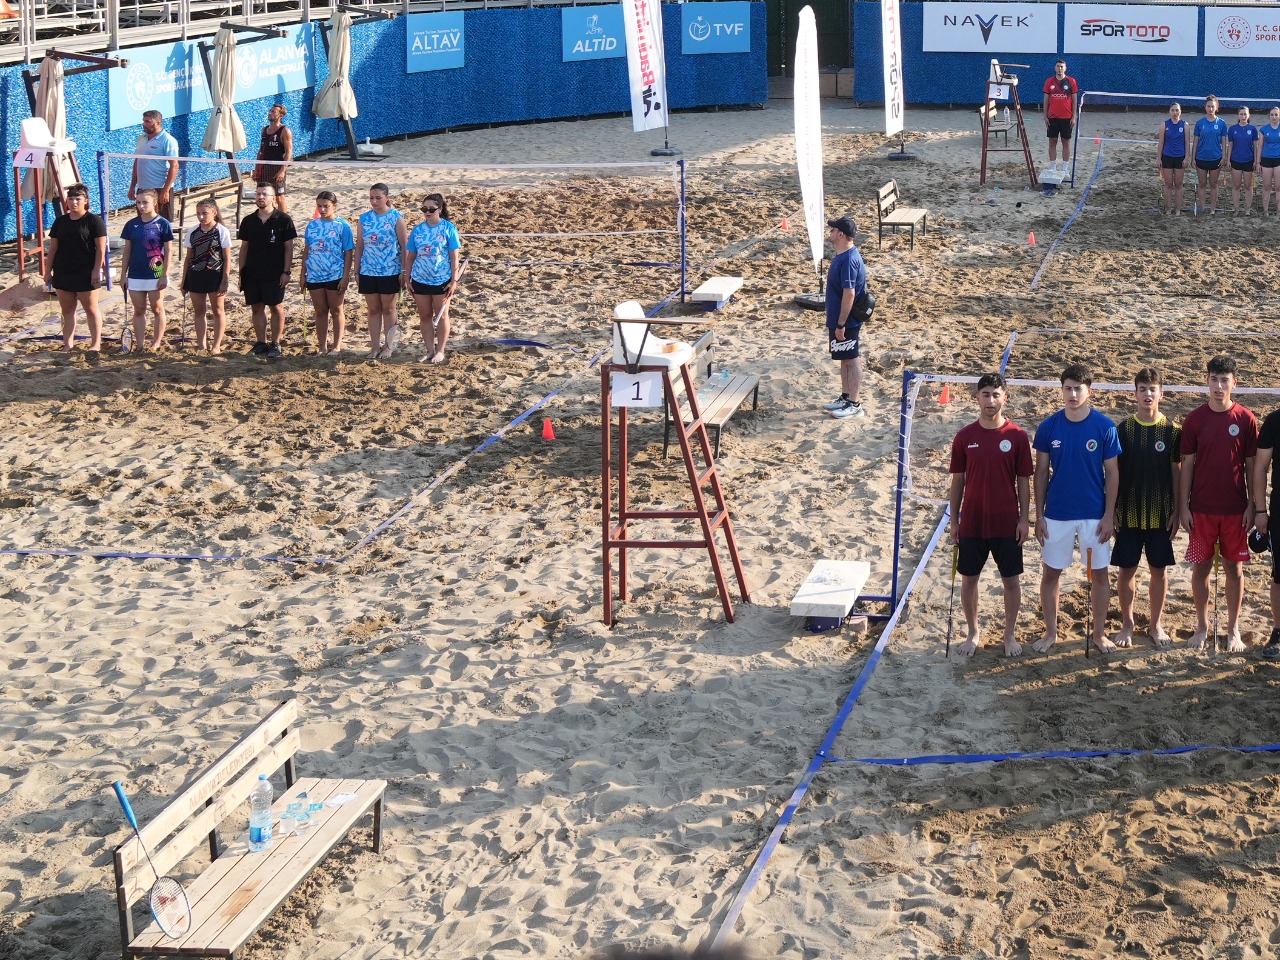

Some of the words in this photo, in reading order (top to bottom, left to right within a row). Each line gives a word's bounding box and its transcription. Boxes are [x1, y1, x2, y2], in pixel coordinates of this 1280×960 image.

[713, 23, 744, 36] TVF
[943, 13, 1030, 46] NAVEK
[1080, 24, 1171, 38] SPORTOTO
[411, 32, 461, 51] ALTAV
[258, 42, 310, 66] ALANYA
[24, 152, 34, 165] 4
[631, 381, 643, 401] 1
